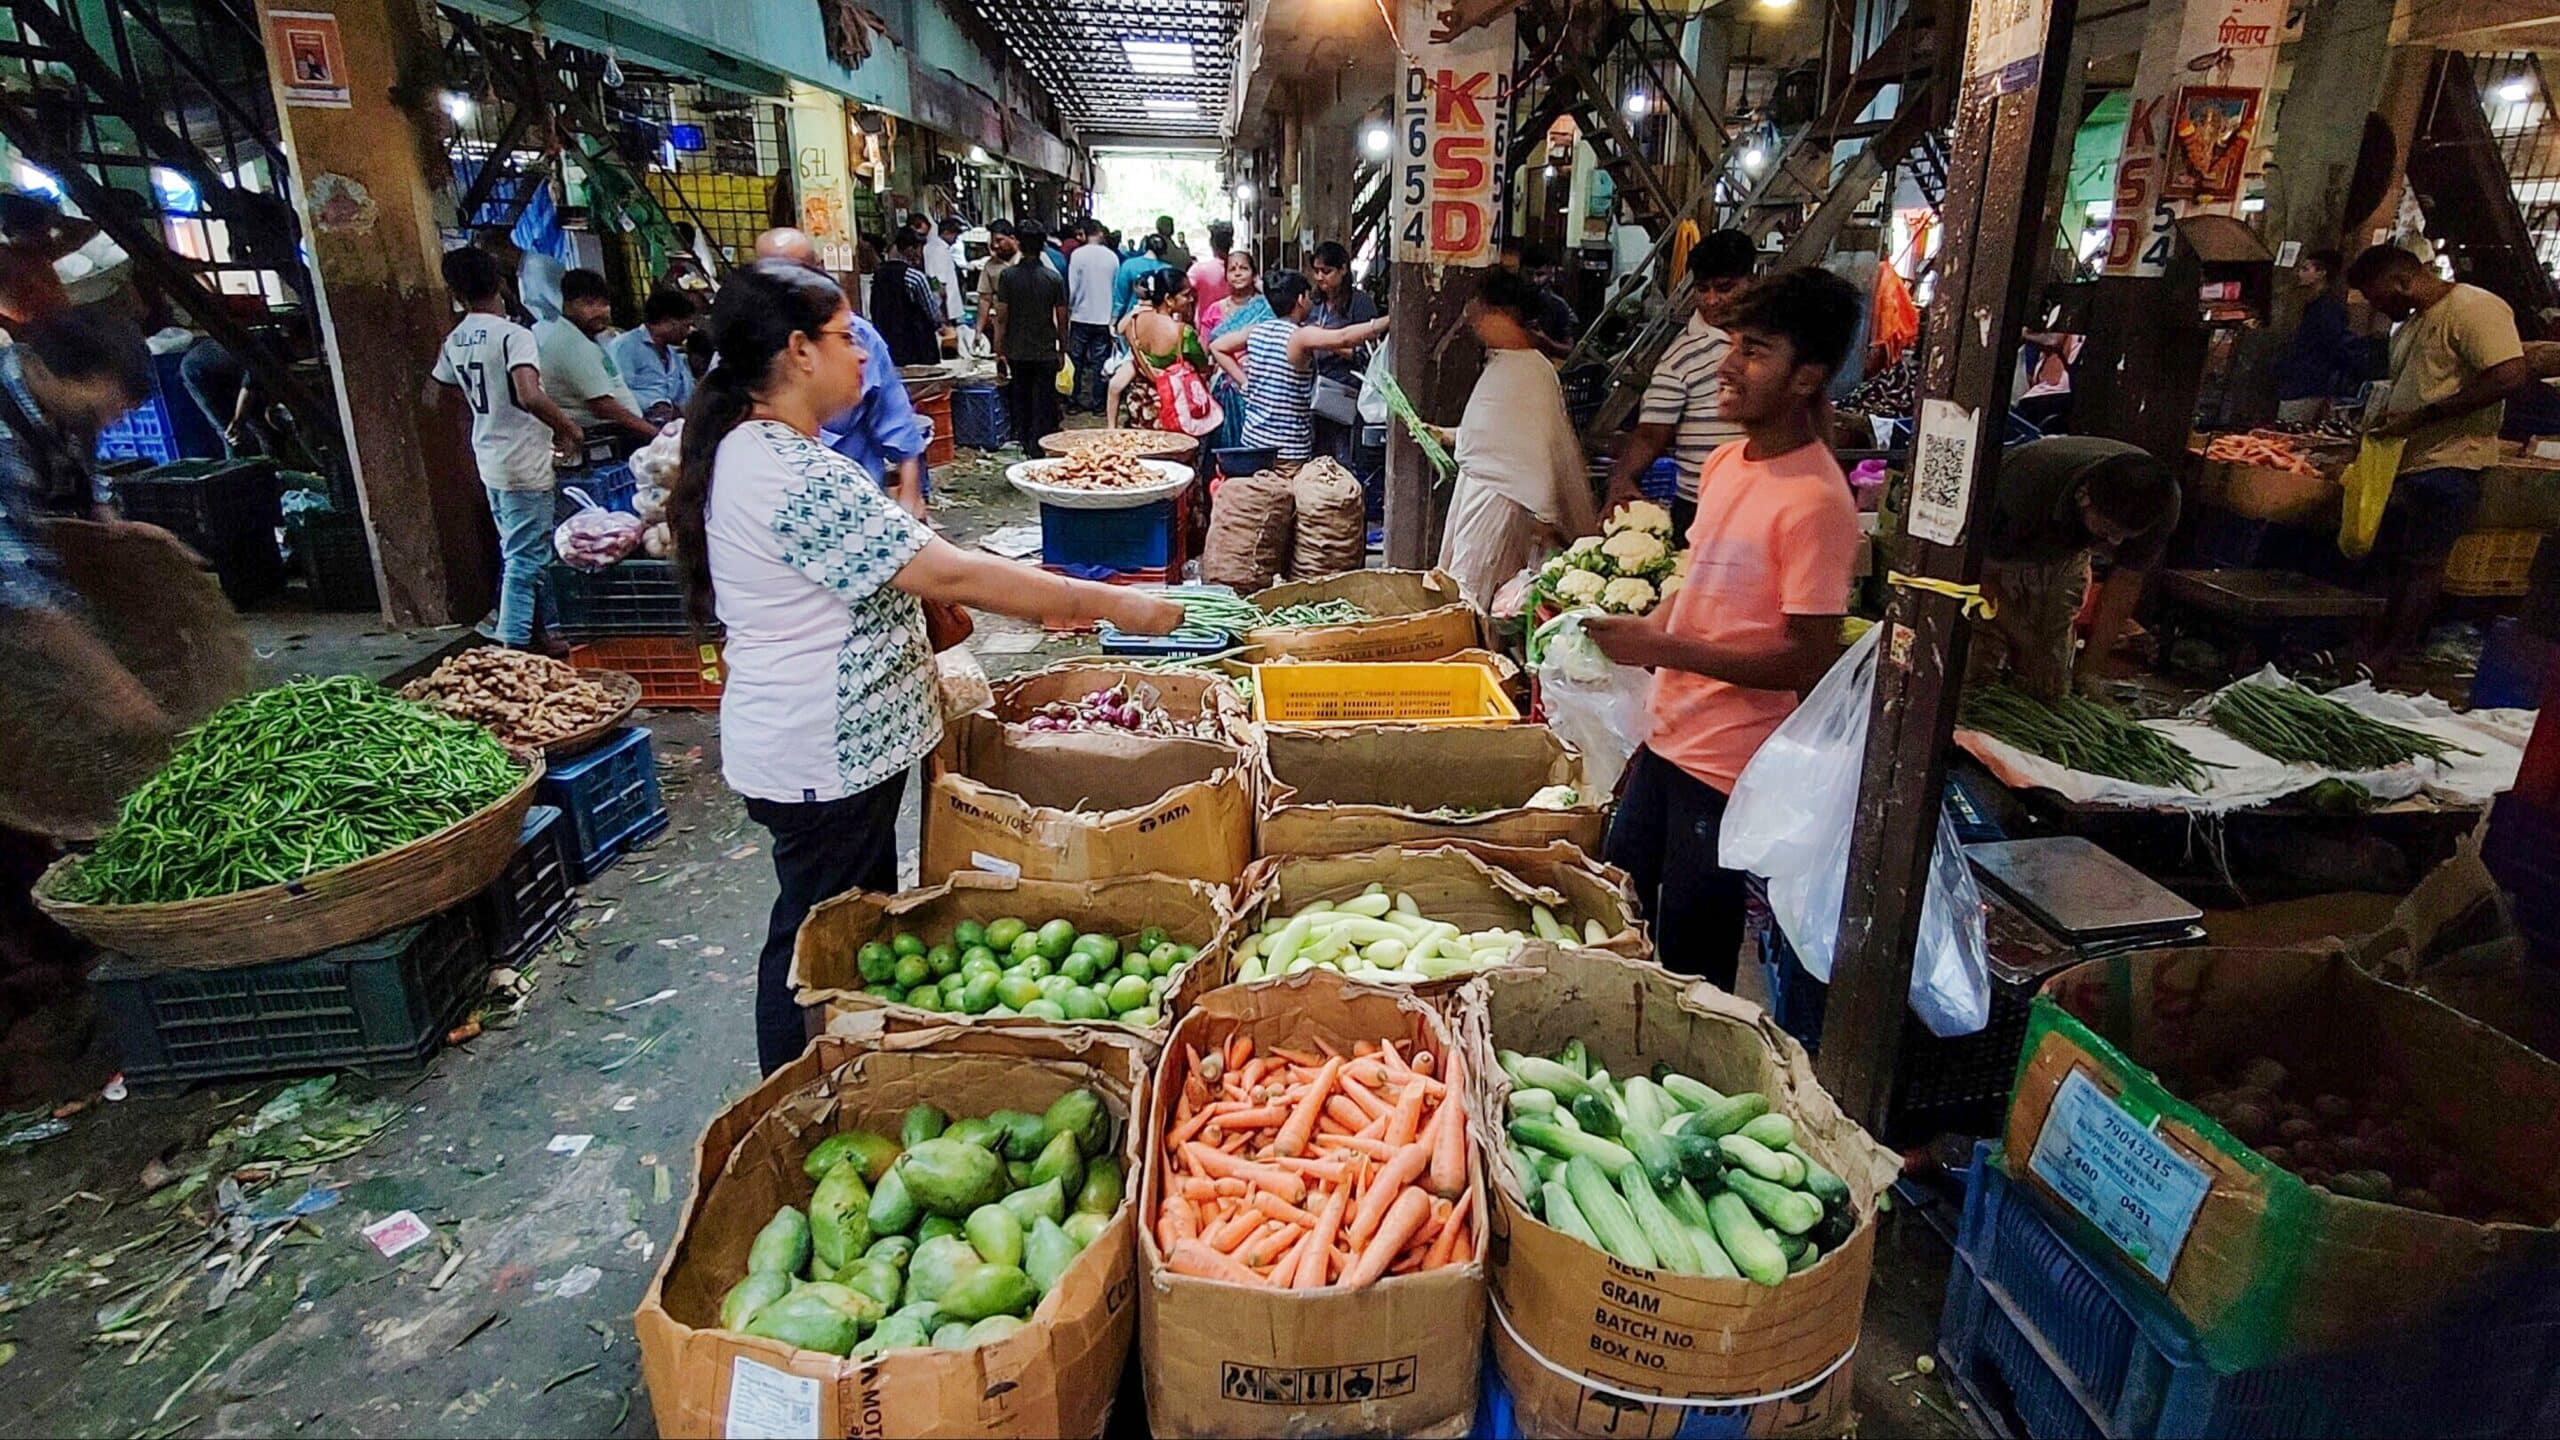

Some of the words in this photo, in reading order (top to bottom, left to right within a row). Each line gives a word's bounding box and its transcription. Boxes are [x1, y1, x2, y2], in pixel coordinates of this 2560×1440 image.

[800, 147, 830, 179] 671
[1431, 69, 1490, 254] KSD
[2107, 94, 2165, 267] KSD
[950, 795, 980, 817] TATA
[1158, 803, 1191, 825] TATA
[2103, 1117, 2172, 1179] 79043215
[1601, 1280, 1661, 1314] GRAM
[1595, 1307, 1658, 1341] BATCH
[1663, 1330, 1697, 1350] NO.
[1590, 1334, 1629, 1360] BOX
[1634, 1350, 1668, 1370] NO.
[862, 1389, 883, 1440] MOT
